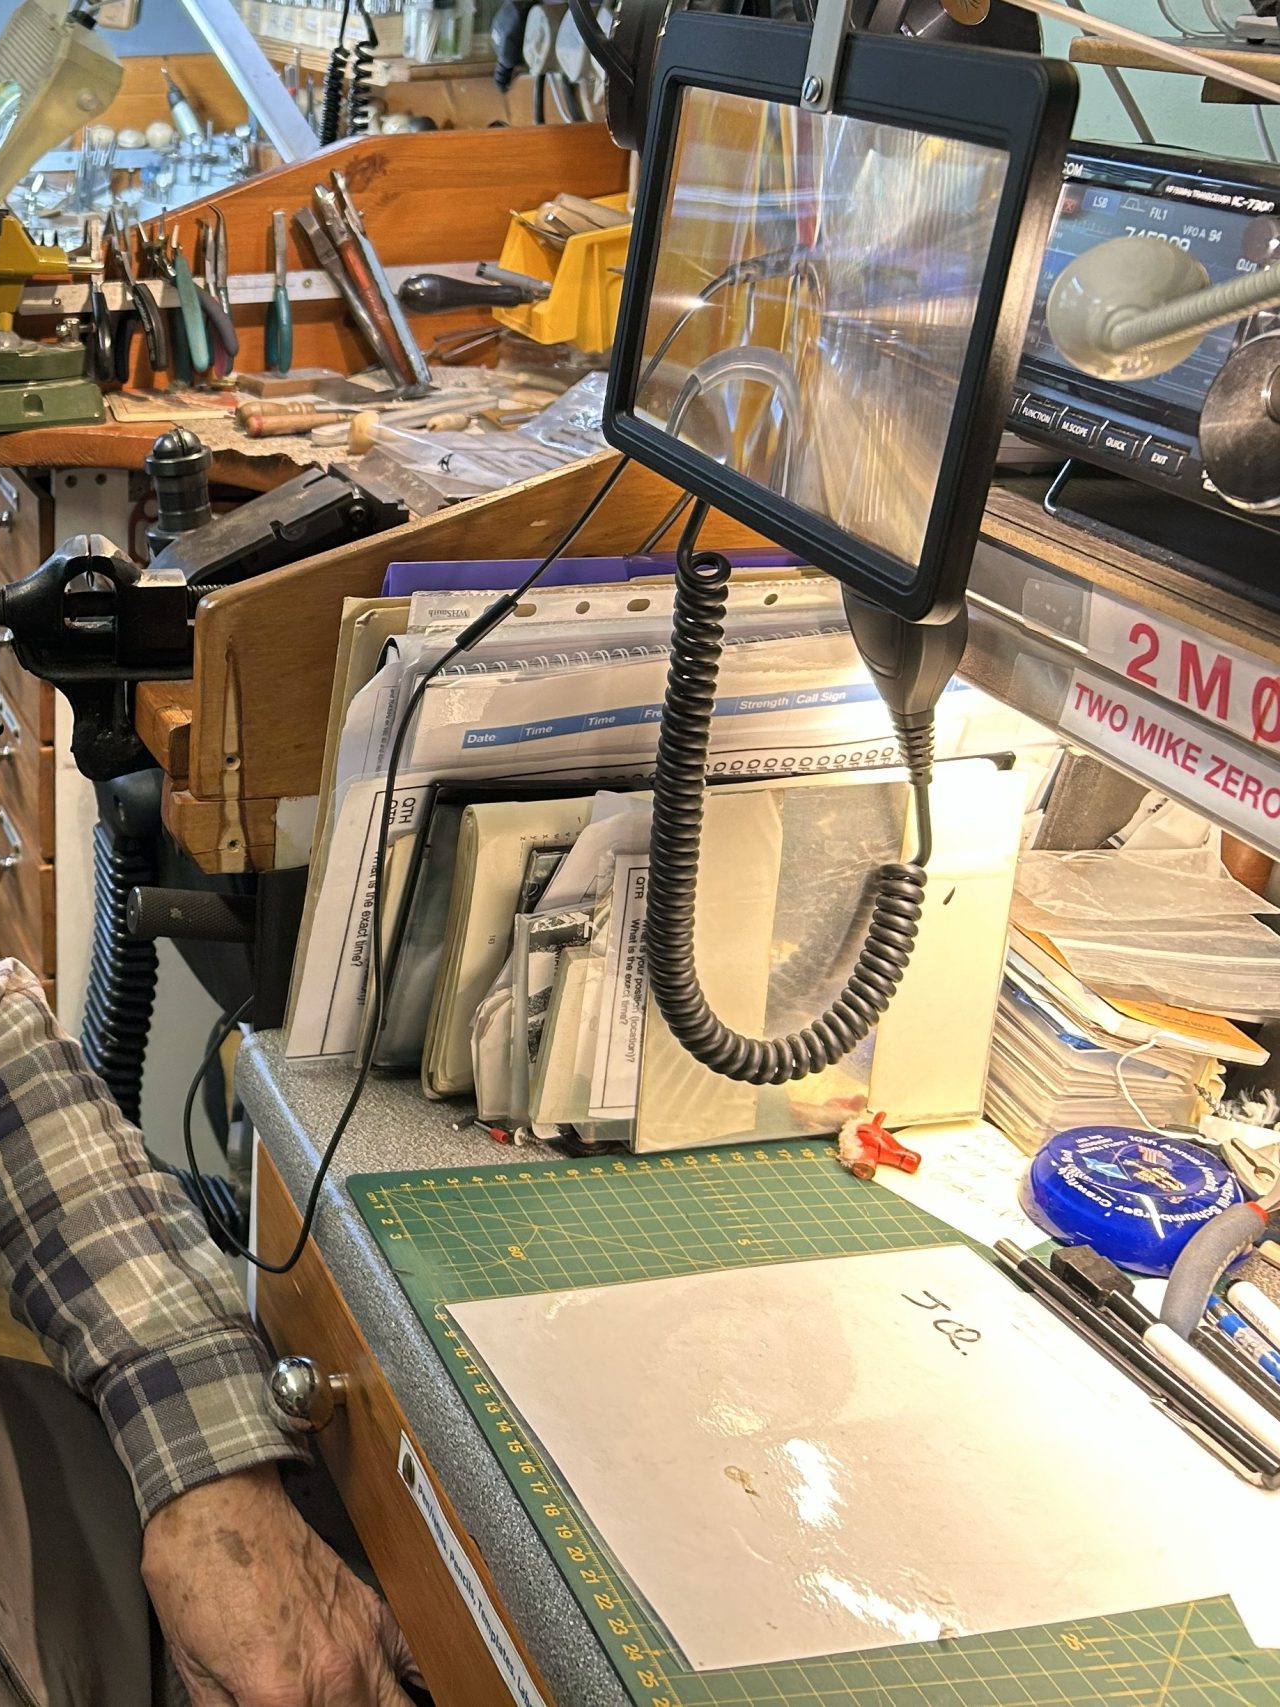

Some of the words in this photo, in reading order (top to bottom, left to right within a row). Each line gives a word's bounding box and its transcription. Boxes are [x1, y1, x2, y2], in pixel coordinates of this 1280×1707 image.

[1092, 195, 1109, 209] LSB
[1148, 206, 1169, 221] FIL1
[1182, 224, 1199, 237] VFO
[1022, 406, 1051, 424] FUNCTION
[1105, 436, 1127, 451] QUICK
[1150, 452, 1169, 466] EXIT
[467, 732, 497, 745] Date
[525, 724, 553, 737] Time
[588, 714, 616, 727] Time
[644, 708, 662, 719] Fre
[739, 696, 789, 711] Strength
[796, 692, 822, 705] Call
[822, 689, 847, 704] Sign
[1075, 682, 1129, 733] TWO
[1131, 715, 1203, 775] MIKE
[1203, 754, 1280, 819] ZERO
[397, 797, 417, 825] QTH
[635, 876, 646, 900] QTR
[364, 891, 375, 909] the
[357, 911, 373, 938] exact
[629, 918, 641, 944] What
[350, 940, 366, 968] time?
[625, 956, 637, 971] the
[635, 955, 647, 976] your
[631, 978, 645, 1014] position
[1128, 1135, 1157, 1147] 10th
[1162, 1143, 1207, 1169] Annual
[422, 1178, 435, 1186] 2
[447, 1177, 459, 1185] 3
[495, 1174, 508, 1182] 5
[519, 1172, 531, 1180] 6
[566, 1168, 580, 1176] 8
[612, 1162, 627, 1173] 10
[636, 1160, 650, 1170] 11
[660, 1158, 675, 1168] 12
[684, 1156, 698, 1166] 13
[707, 1153, 721, 1163] 14
[730, 1151, 745, 1162] 15
[754, 1150, 769, 1161] 16
[777, 1149, 792, 1159] 17
[800, 1147, 816, 1158] 18
[1115, 1202, 1223, 1224] Schlumbrger
[737, 1238, 751, 1247] 5
[435, 1312, 448, 1321] 8
[444, 1330, 457, 1338] 9
[454, 1347, 469, 1358] 10
[464, 1364, 479, 1375] 11
[474, 1382, 491, 1395] 12
[484, 1401, 501, 1414] 13
[495, 1419, 512, 1433] 14
[507, 1439, 524, 1453] 15
[518, 1459, 536, 1474] 16
[530, 1481, 548, 1495] 17
[543, 1502, 560, 1517] 18
[555, 1524, 573, 1539] 19
[566, 1546, 586, 1562] 20
[580, 1569, 600, 1584] 21
[593, 1593, 614, 1610] 22
[607, 1618, 629, 1635] 23
[622, 1643, 644, 1661] 24
[637, 1670, 659, 1688] 25
